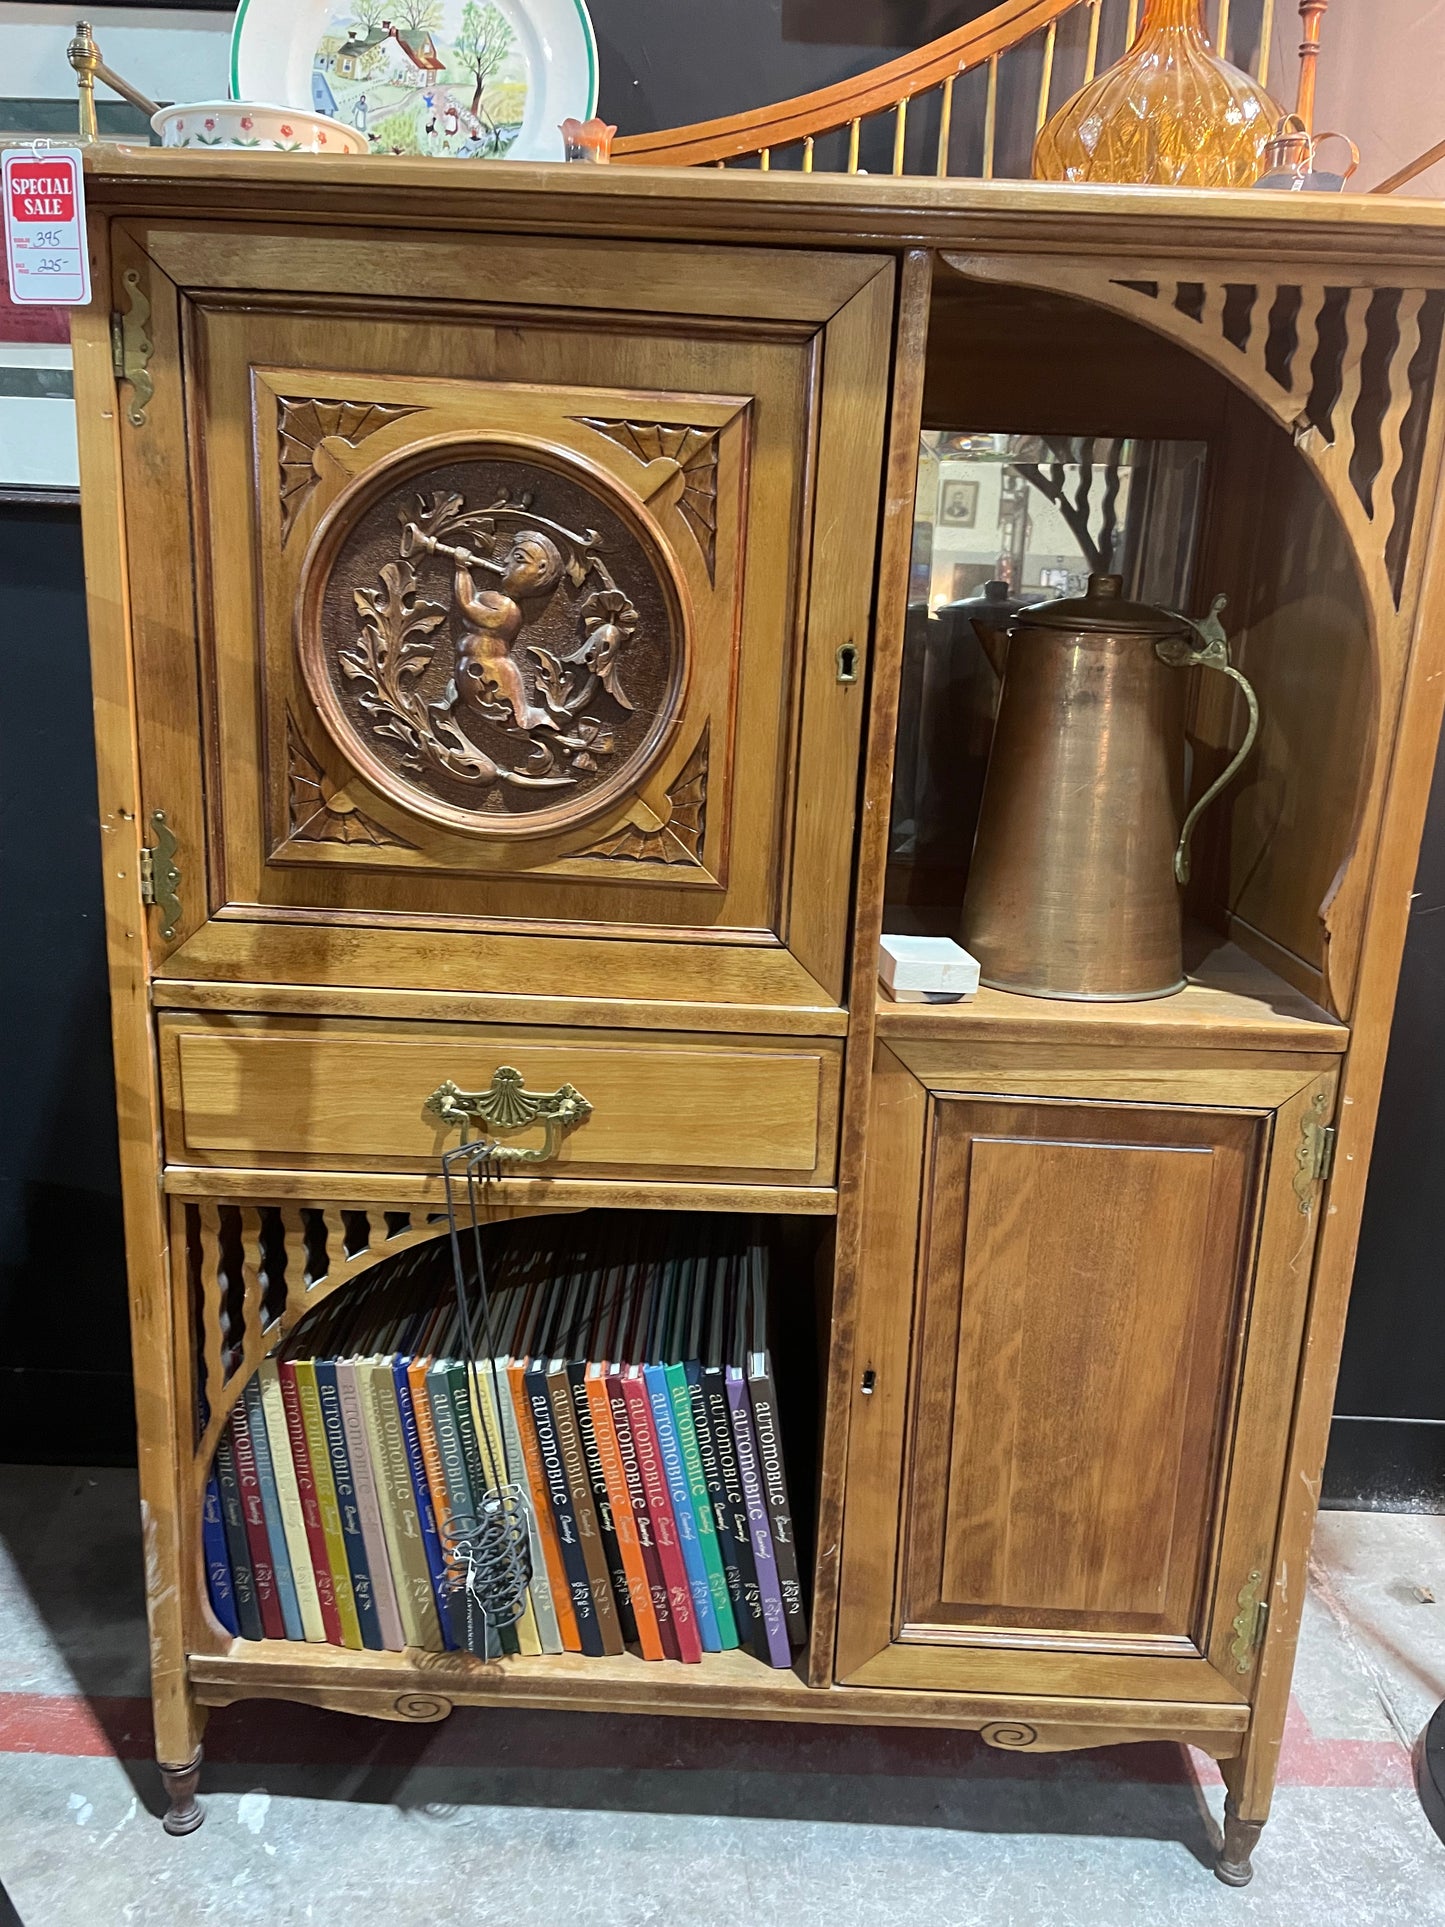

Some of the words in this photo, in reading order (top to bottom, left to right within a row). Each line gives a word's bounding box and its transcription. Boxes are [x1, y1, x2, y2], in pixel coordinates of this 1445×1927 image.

[12, 178, 72, 195] SPECIAL
[24, 198, 63, 215] SALE
[33, 230, 62, 247] 395
[235, 1397, 256, 1487] TOMOBILE
[733, 1409, 763, 1521] AUTOMOBILE
[755, 1401, 785, 1506] AUTOMOBILE
